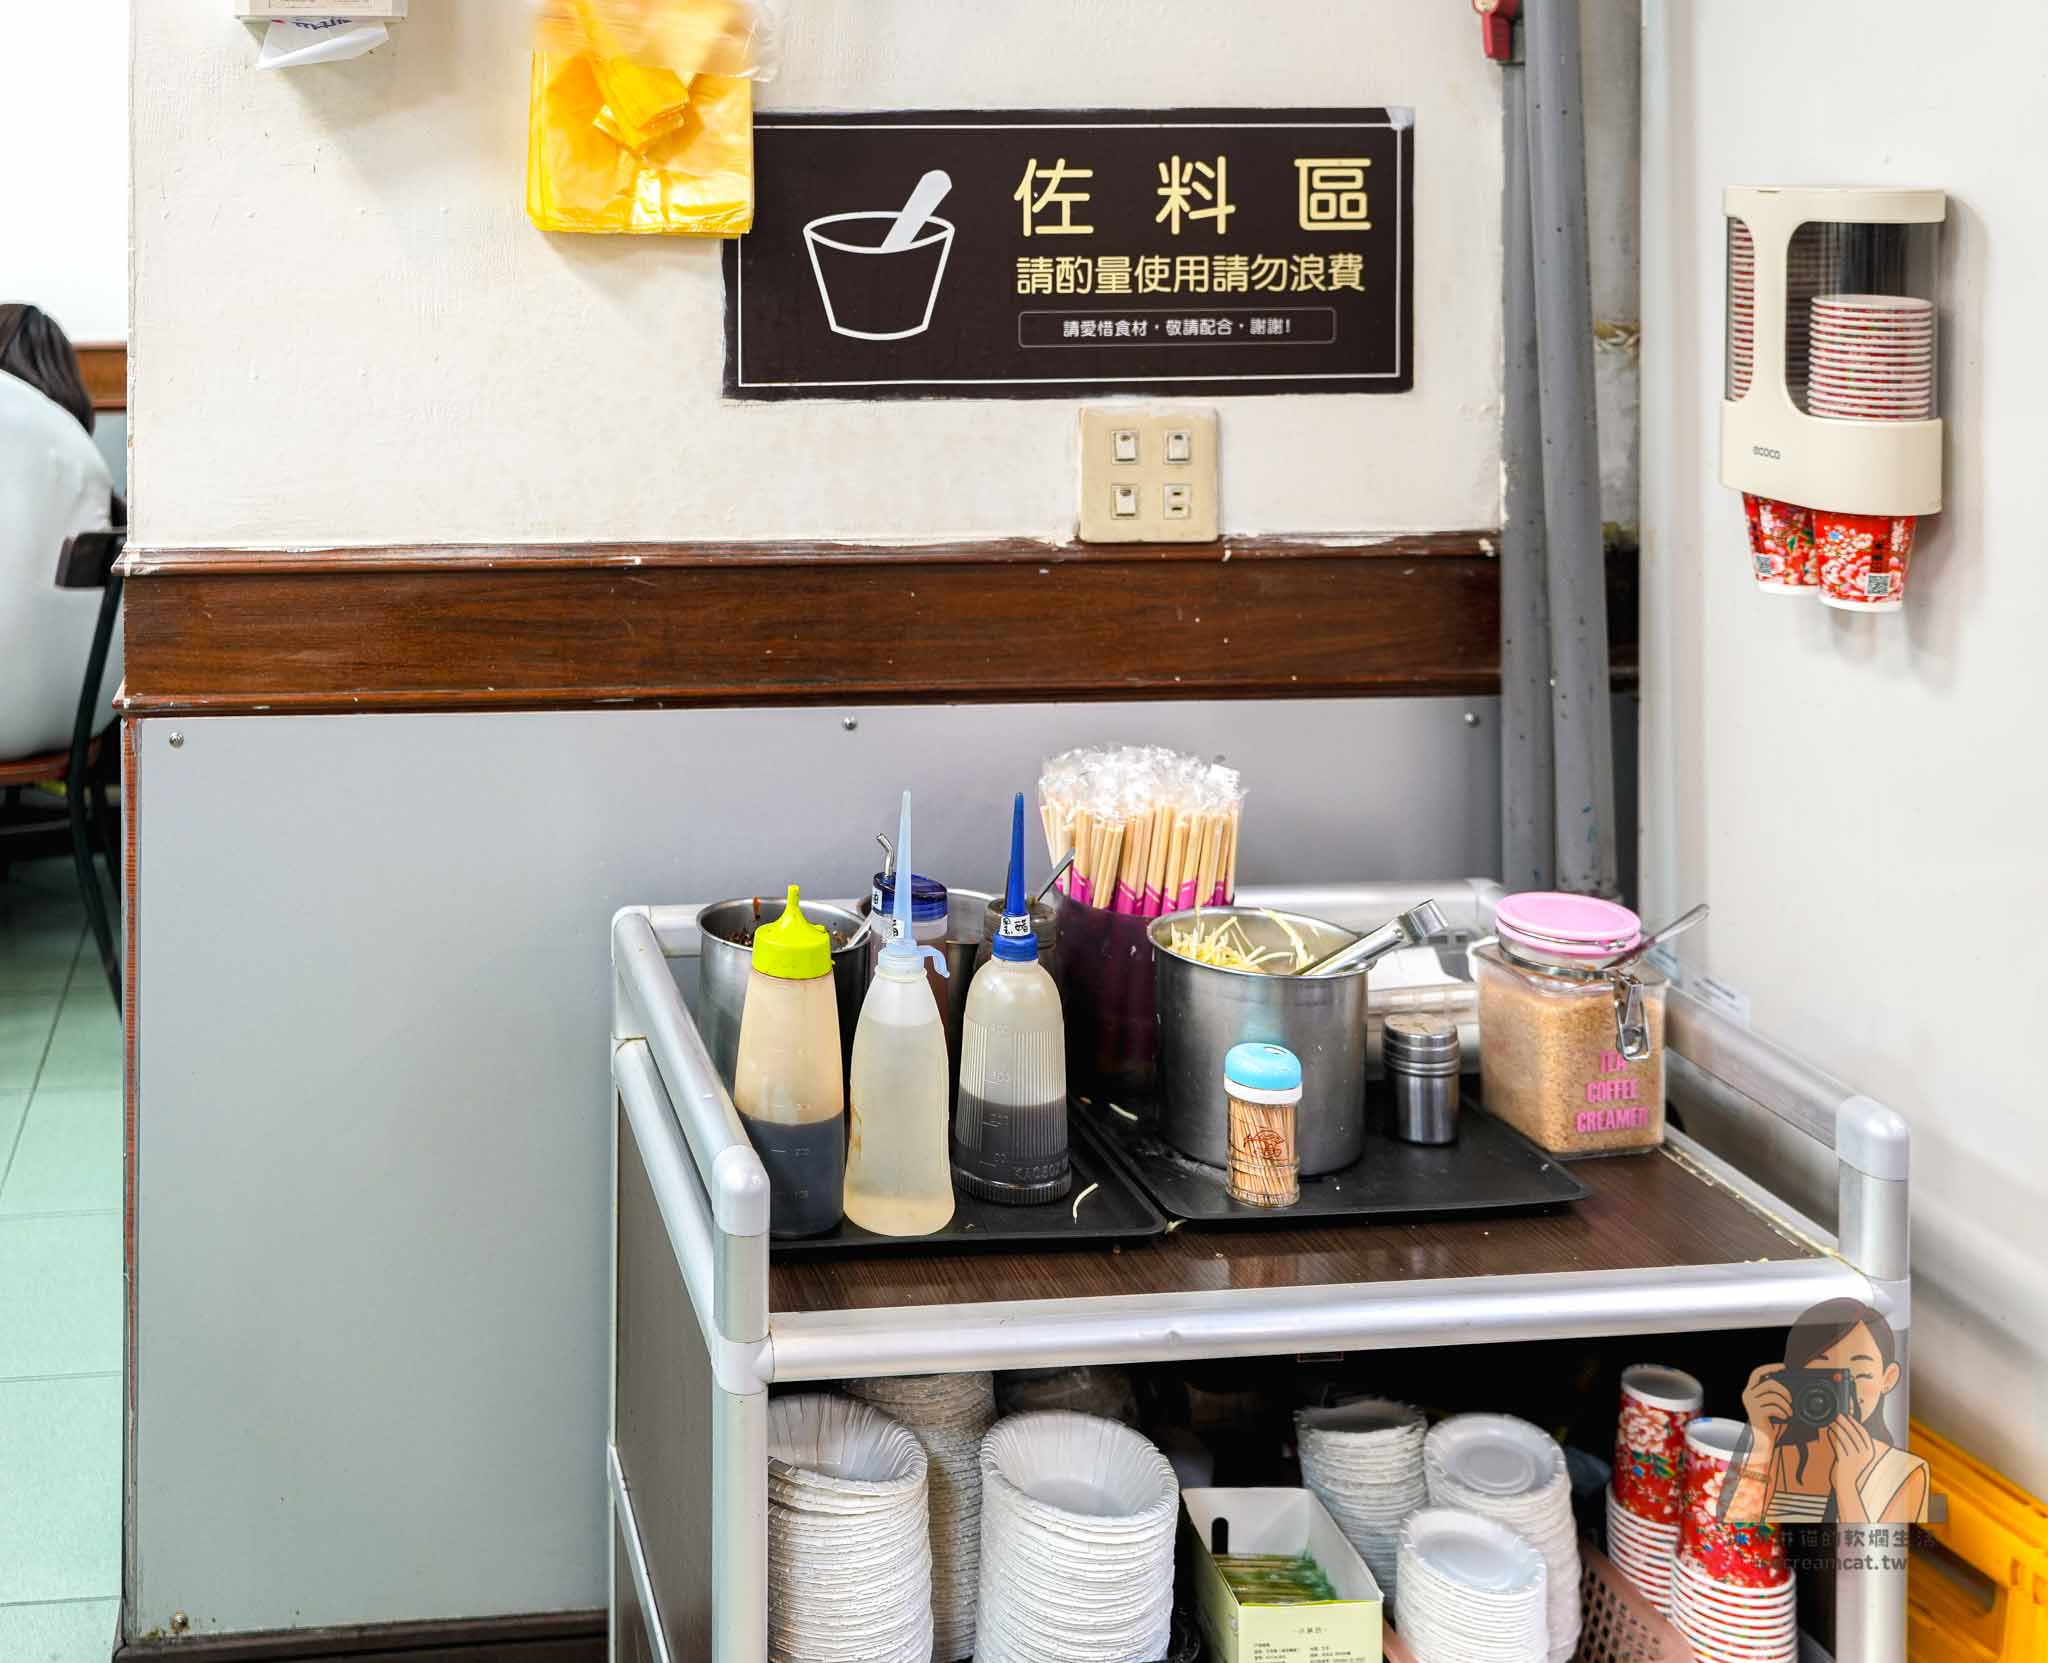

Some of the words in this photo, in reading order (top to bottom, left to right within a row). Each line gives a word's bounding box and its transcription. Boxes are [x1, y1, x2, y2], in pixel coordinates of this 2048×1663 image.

[1013, 155, 1372, 238] 佐料區
[1015, 252, 1366, 295] 請酌量使用請勿浪費
[1585, 1077, 1639, 1104] COFFEE
[1575, 1106, 1649, 1134] CREAMER
